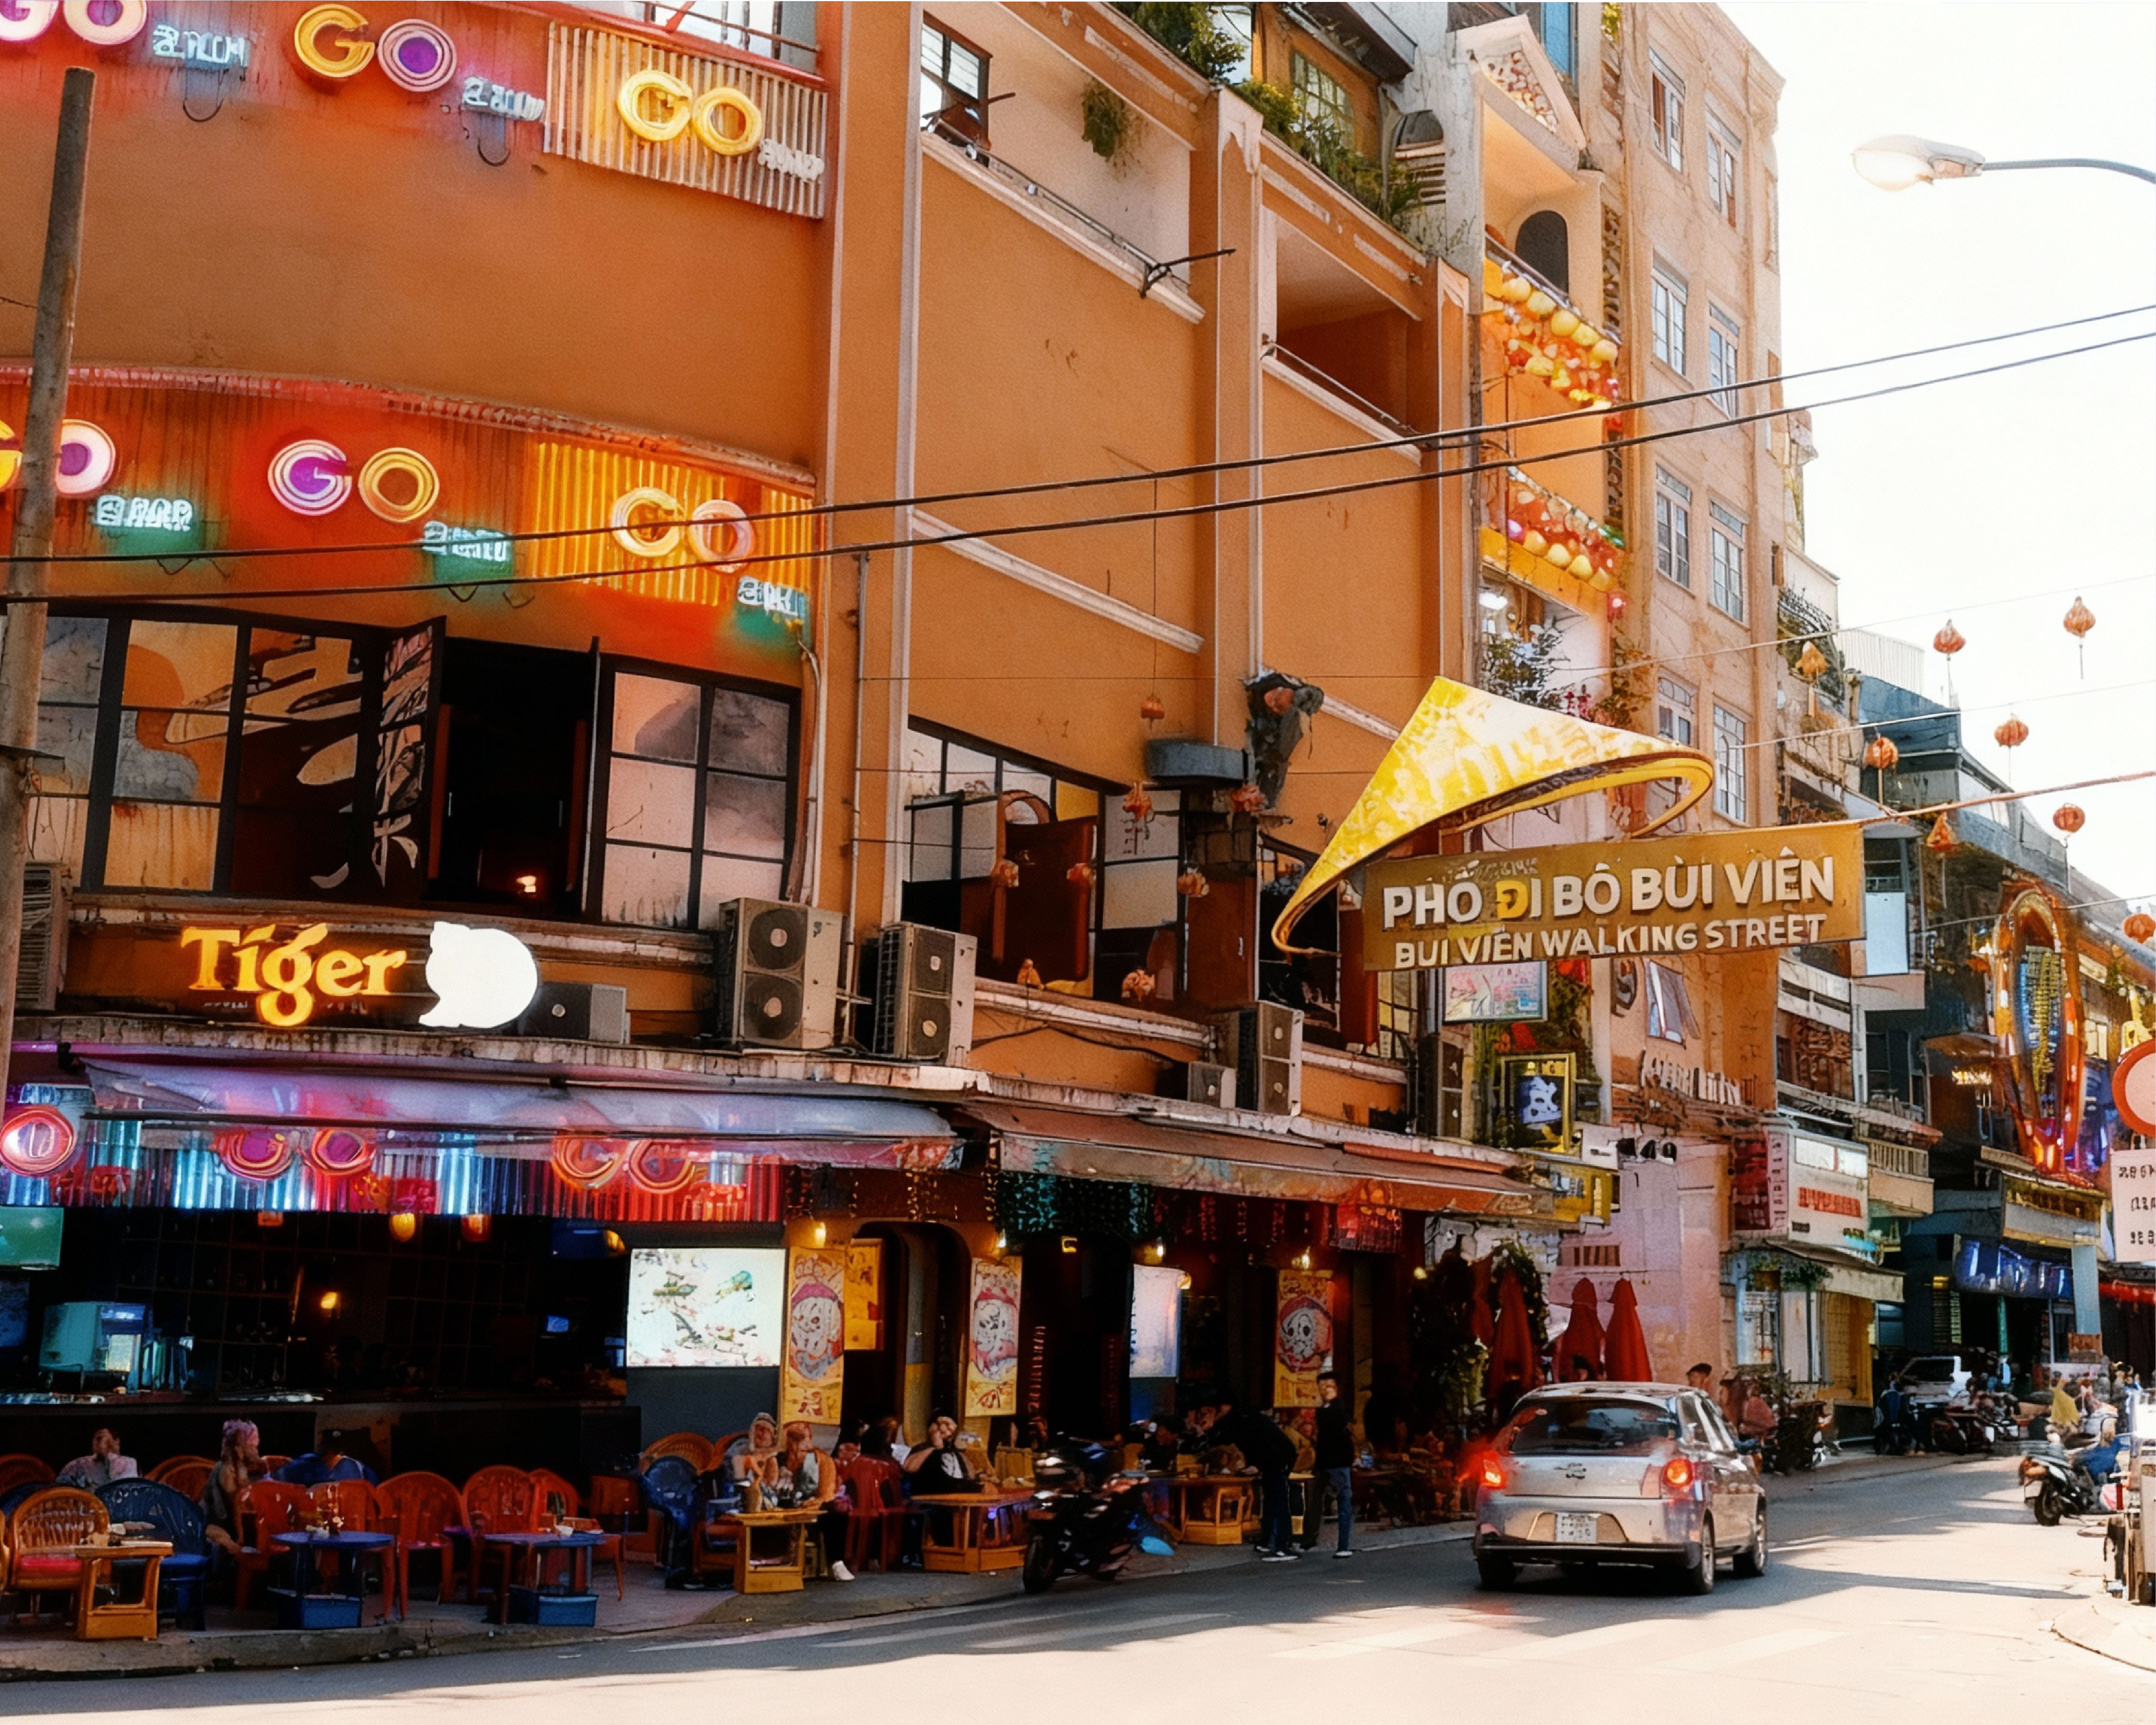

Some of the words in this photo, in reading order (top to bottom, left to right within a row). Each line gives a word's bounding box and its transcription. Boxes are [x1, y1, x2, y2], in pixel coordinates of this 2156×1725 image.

[294, 3, 458, 92] GO
[268, 439, 440, 522] GO
[1495, 878, 1542, 919] ĐI
[1631, 847, 1713, 911] BÙI
[181, 922, 407, 1026] Tiger
[1541, 921, 1699, 957] WALKING
[1704, 914, 1828, 950] STREET
